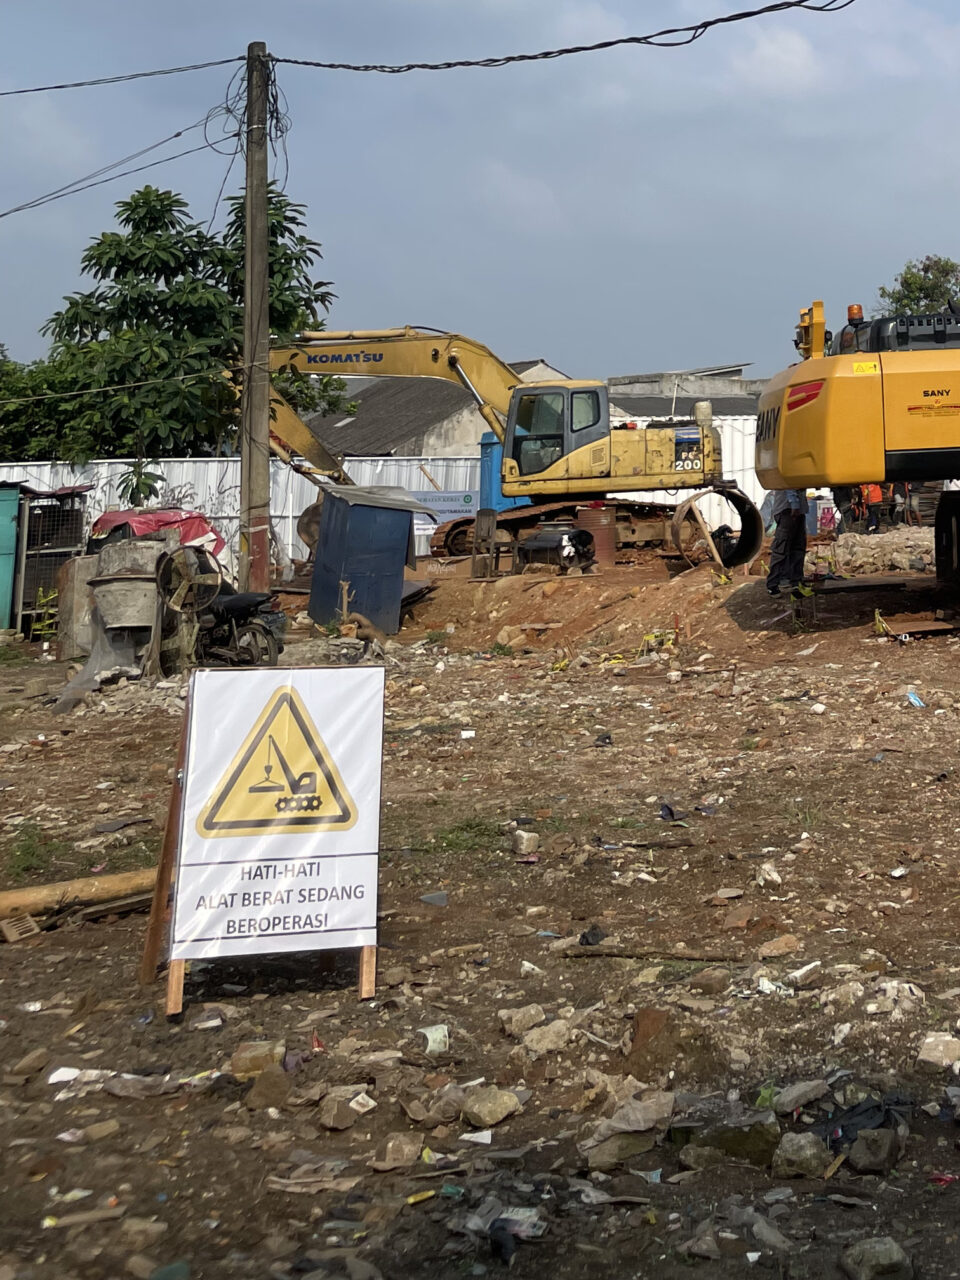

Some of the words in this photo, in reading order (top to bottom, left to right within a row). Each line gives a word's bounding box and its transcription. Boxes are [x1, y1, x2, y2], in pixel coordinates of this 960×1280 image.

[307, 353, 384, 364] KOMATSU
[923, 389, 951, 397] SANY
[675, 459, 701, 471] 200
[240, 862, 321, 881] HATI-HATI
[195, 892, 238, 911] ALAT
[241, 889, 294, 907] BERAT
[297, 884, 365, 904] SEDANG
[226, 913, 329, 935] BEROPERASI
